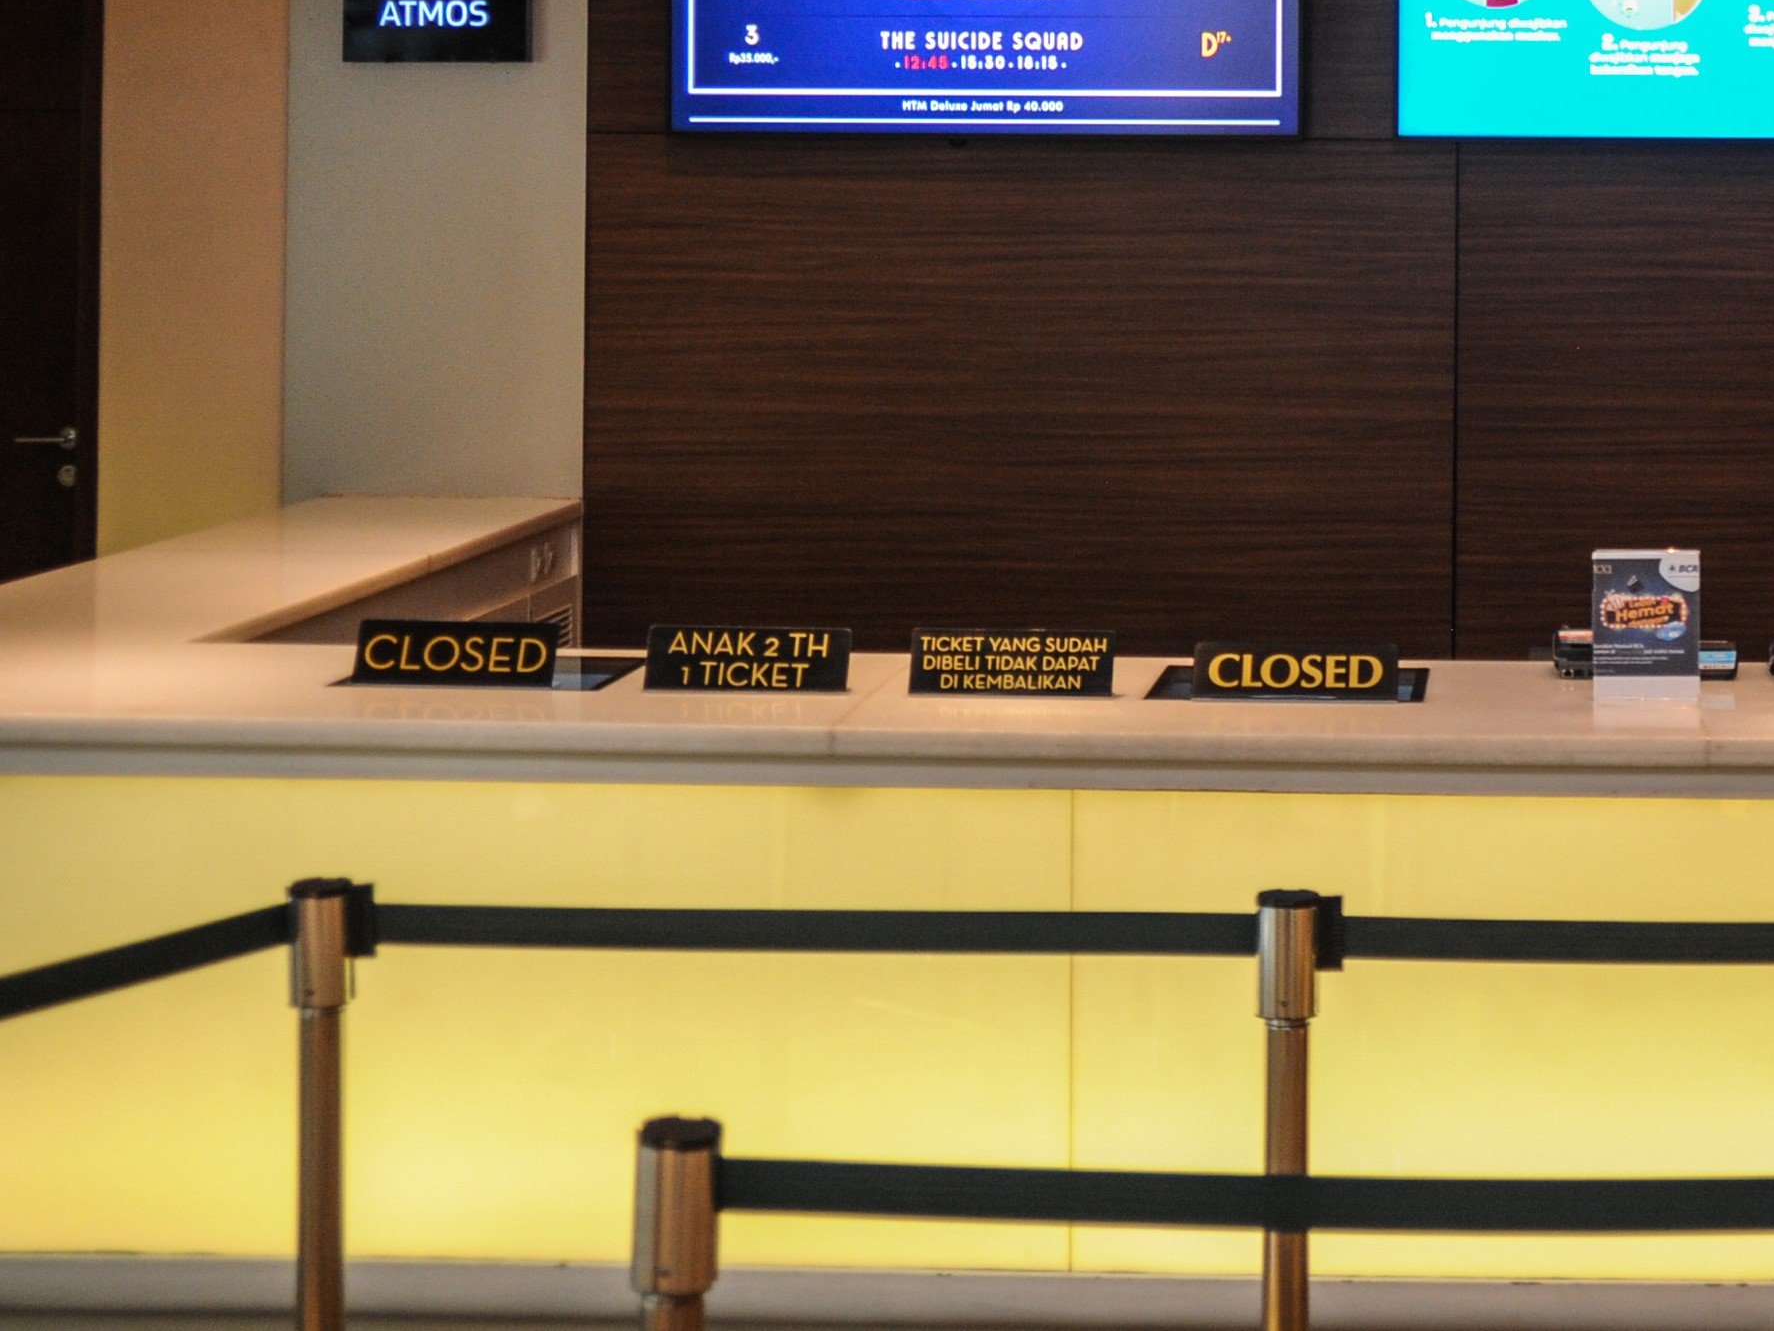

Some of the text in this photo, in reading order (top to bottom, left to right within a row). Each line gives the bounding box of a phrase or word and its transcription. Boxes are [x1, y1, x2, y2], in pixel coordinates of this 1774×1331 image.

[379, 0, 489, 27] ATMOS
[744, 24, 760, 45] 3
[880, 30, 1084, 51] THE SUICIDE SQUAD
[902, 99, 1064, 114] HTM Deluxe Jumat Rp 40.000
[1616, 603, 1675, 623] Hemat
[364, 634, 547, 673] CLOSED
[668, 630, 829, 659] ANAK 2 TH
[921, 636, 1107, 653] TICKET YANG SUDAH
[923, 654, 1100, 672] DIBELI TIDAK DAPAT
[1208, 652, 1384, 689] CLOSED
[681, 661, 810, 689] 1 TICKET
[940, 673, 1081, 690] DI KEMBALIKAN
